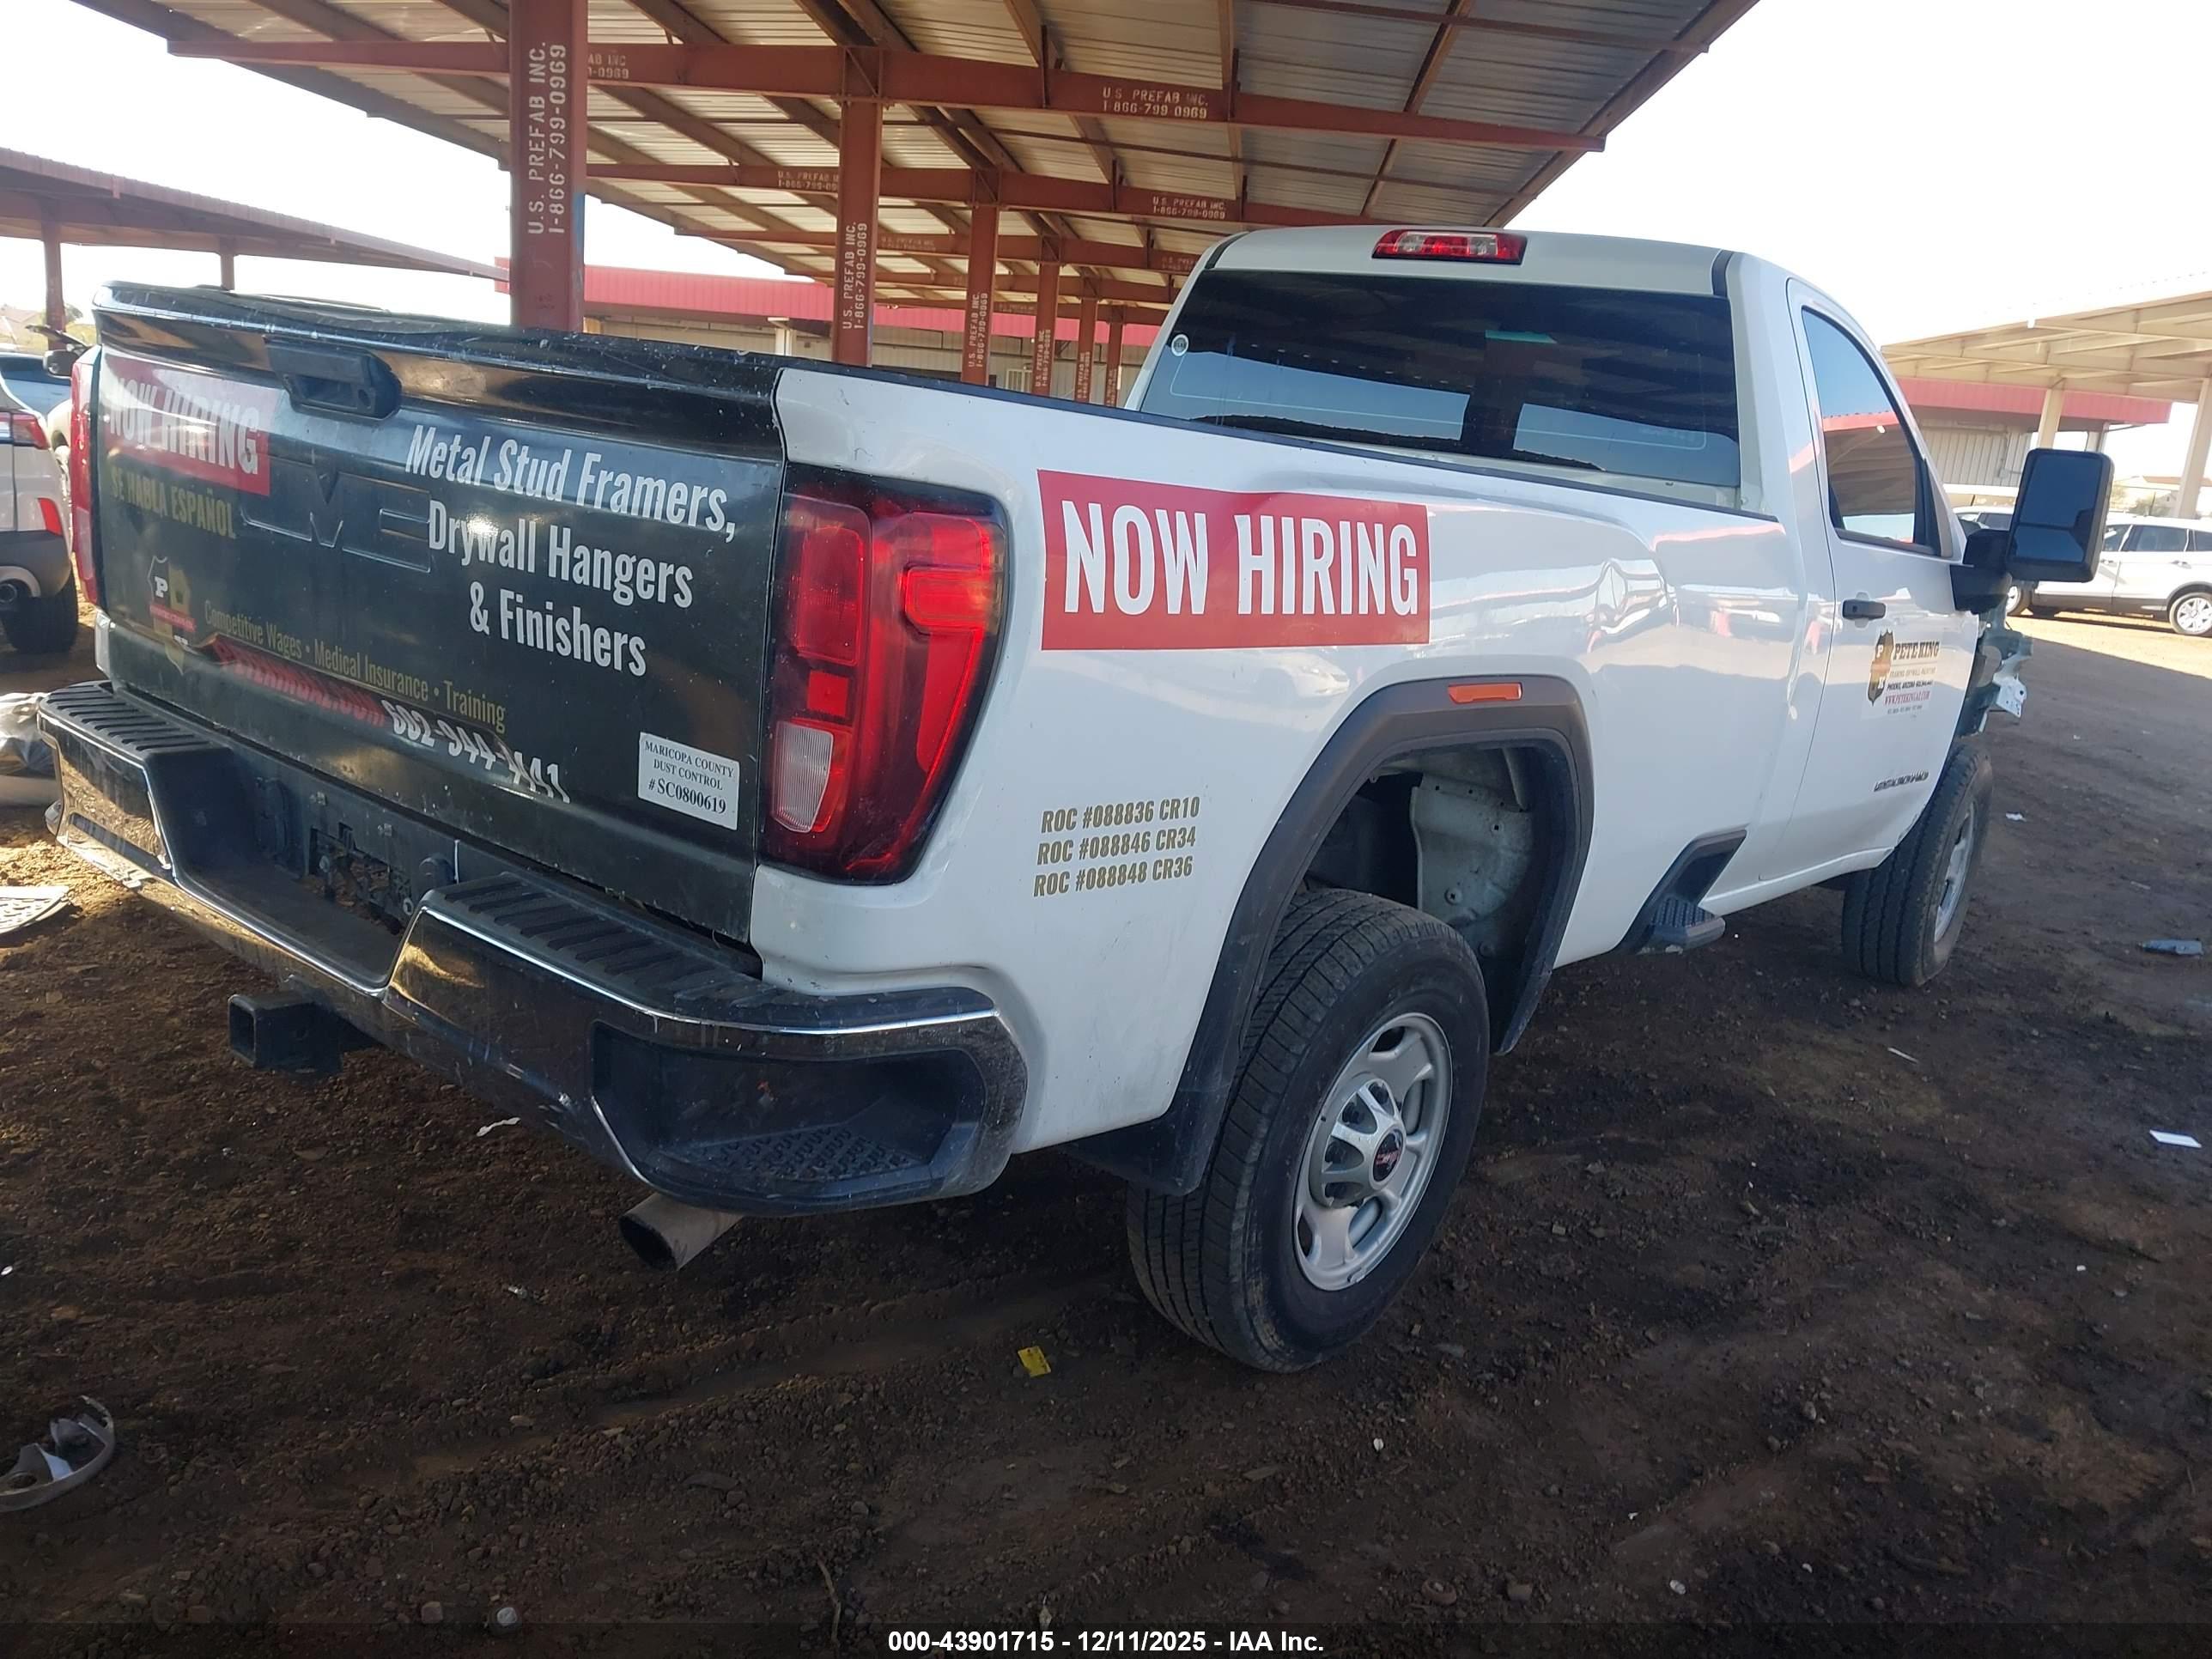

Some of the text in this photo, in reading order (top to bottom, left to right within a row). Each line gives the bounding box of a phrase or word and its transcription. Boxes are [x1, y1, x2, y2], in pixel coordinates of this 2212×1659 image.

[528, 42, 546, 234] U.S. PREFAB INC.
[549, 45, 567, 234] 1-866-799-0969
[1133, 89, 1181, 104] PREFAB
[1173, 198, 1207, 209] PREFAB
[842, 222, 857, 330] U.S. PREFAB INC.
[854, 223, 867, 329] 1-866-799-0969
[110, 378, 259, 475] NOW HIRING
[126, 471, 168, 519] HABLA
[172, 485, 237, 539] ESPAÑOL
[405, 424, 737, 544] Metal Stud Framers,
[429, 500, 537, 574] Drywall
[548, 525, 694, 610] Hangers
[1060, 500, 1419, 617] NOW HIRING
[204, 599, 264, 645] Competitive
[266, 622, 302, 660] Wages
[314, 638, 361, 678] Medical
[365, 655, 428, 702] Insurance
[443, 679, 507, 735] Training
[470, 580, 647, 678] & Finishers
[645, 740, 734, 778] MARICOPA COUNTY
[653, 758, 723, 791] DUST CONTROL
[1036, 826, 1196, 866] ROC #088846 CR34
[1041, 796, 1200, 834] ROC #088836 CR10
[1033, 855, 1194, 897] ROC #088848 CR36
